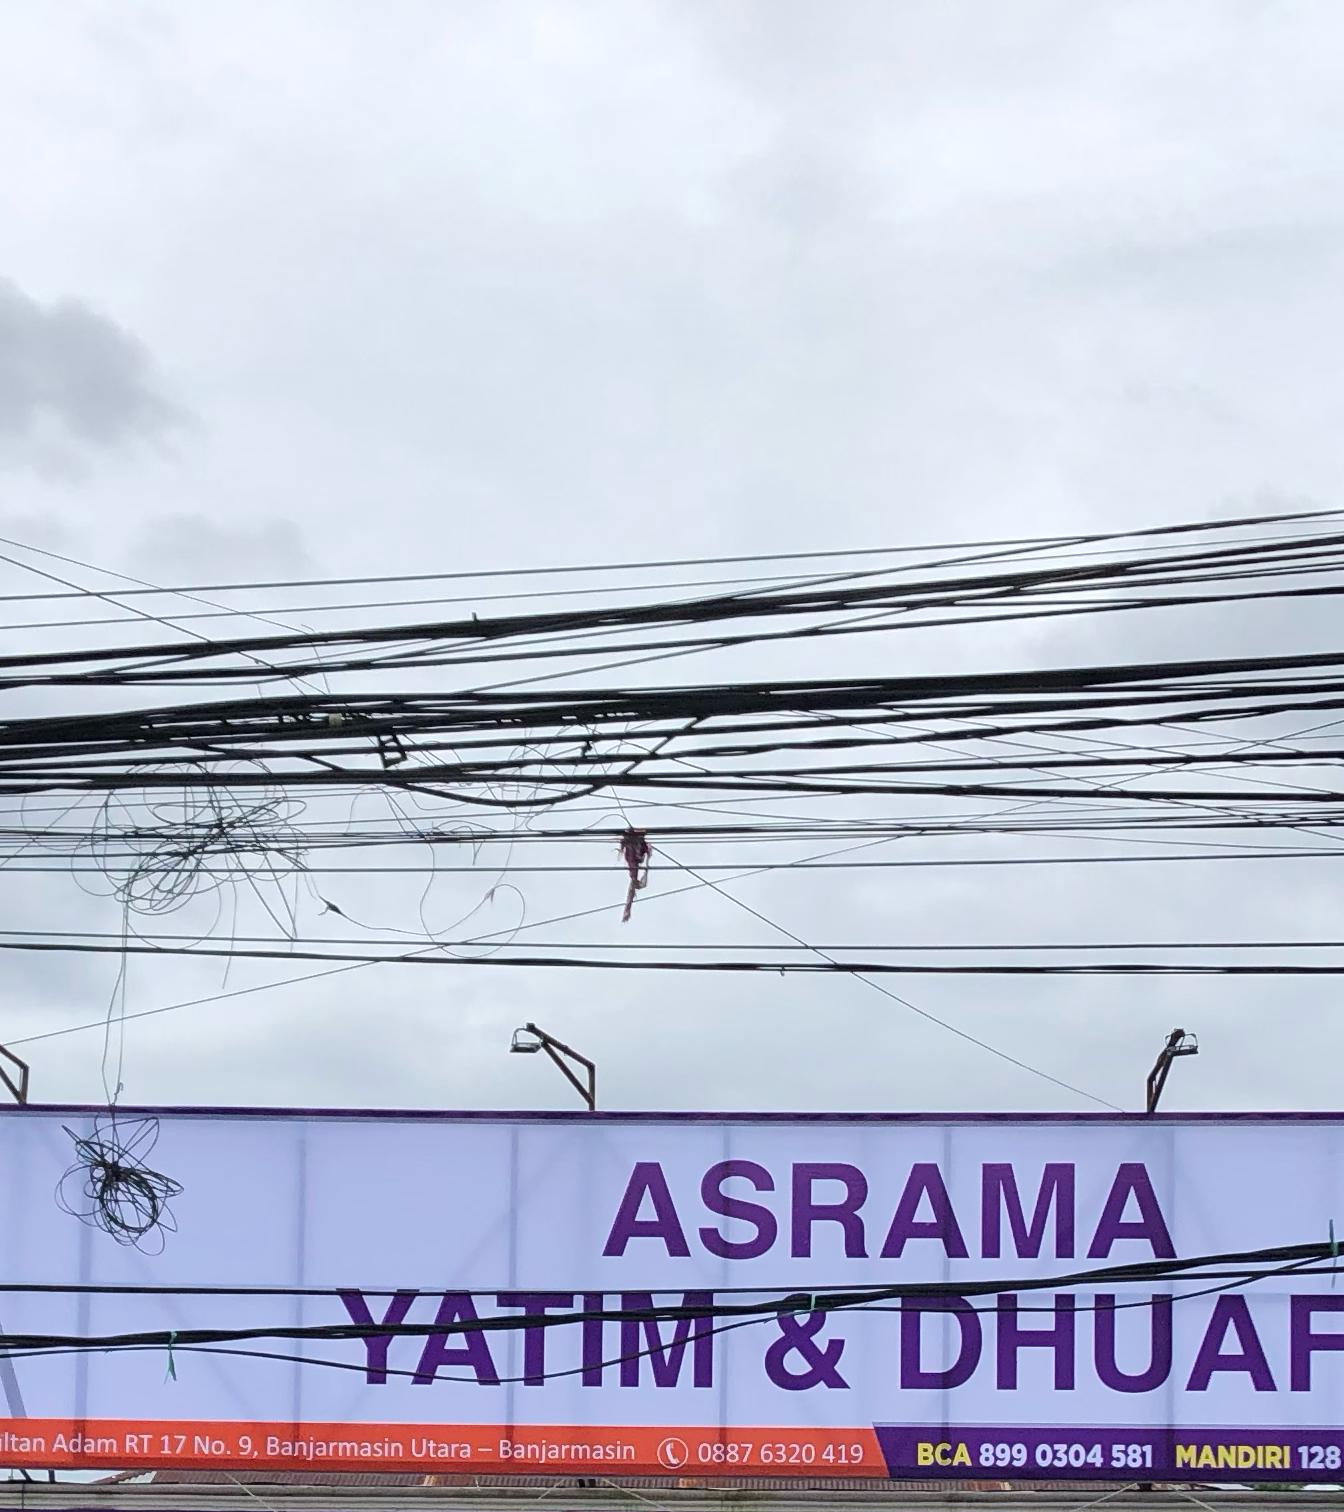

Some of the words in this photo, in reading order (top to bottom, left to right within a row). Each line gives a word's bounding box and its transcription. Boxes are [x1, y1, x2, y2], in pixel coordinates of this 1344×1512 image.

[601, 1161, 1178, 1260] ASRAMA
[335, 1289, 715, 1388] YATIM
[762, 1292, 852, 1392] &
[52, 1433, 117, 1454] Adam
[124, 1434, 153, 1454] RT
[160, 1435, 185, 1454] 17
[194, 1435, 230, 1455] No.
[238, 1436, 258, 1458] 9,
[266, 1436, 403, 1461] Banjarmasin
[410, 1440, 471, 1459] Utara
[499, 1440, 636, 1464] Banjarmasin
[698, 1442, 753, 1463] 0887
[760, 1443, 816, 1463] 6320
[821, 1443, 864, 1464] 419
[916, 1442, 972, 1467] BCA
[978, 1443, 1028, 1467] 899
[1035, 1443, 1104, 1468] 0304
[1110, 1444, 1154, 1468] 581
[1175, 1445, 1290, 1469] MANDIRI
[1298, 1445, 1342, 1470] 128
